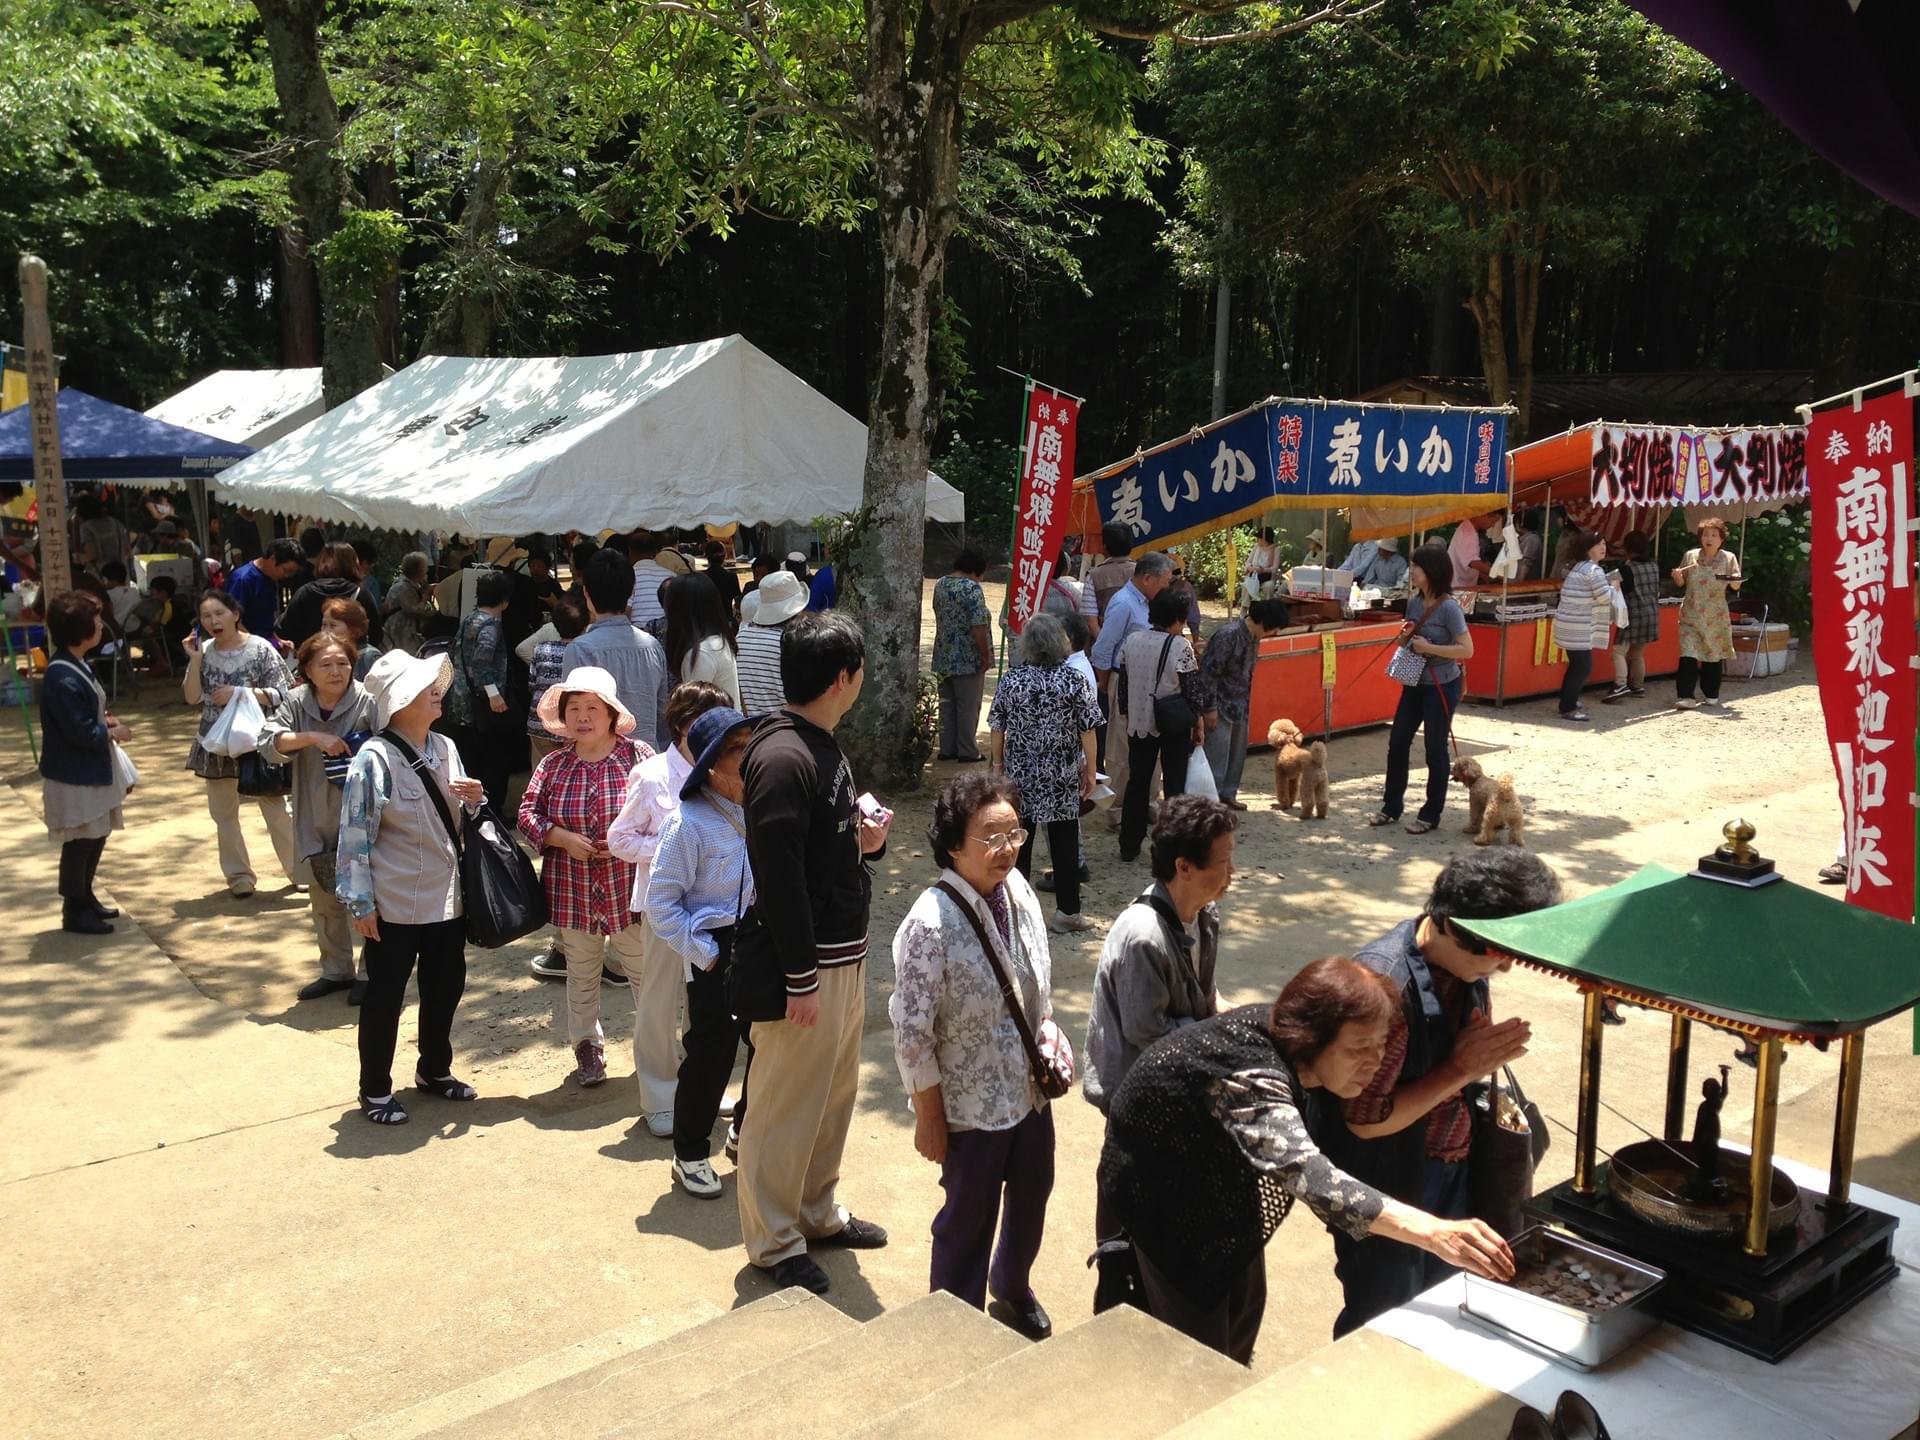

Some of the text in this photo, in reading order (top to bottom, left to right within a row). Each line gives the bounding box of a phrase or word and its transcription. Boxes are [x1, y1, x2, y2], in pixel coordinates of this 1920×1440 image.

[1276, 414, 1303, 485] 特製
[1326, 417, 1453, 488] 煮いか
[1473, 420, 1495, 485] 味自慢
[1592, 428, 1674, 501] 大判焼
[1713, 431, 1806, 499] 大判焼
[1824, 419, 1893, 465] 奉納
[1110, 439, 1256, 539] 煮いか
